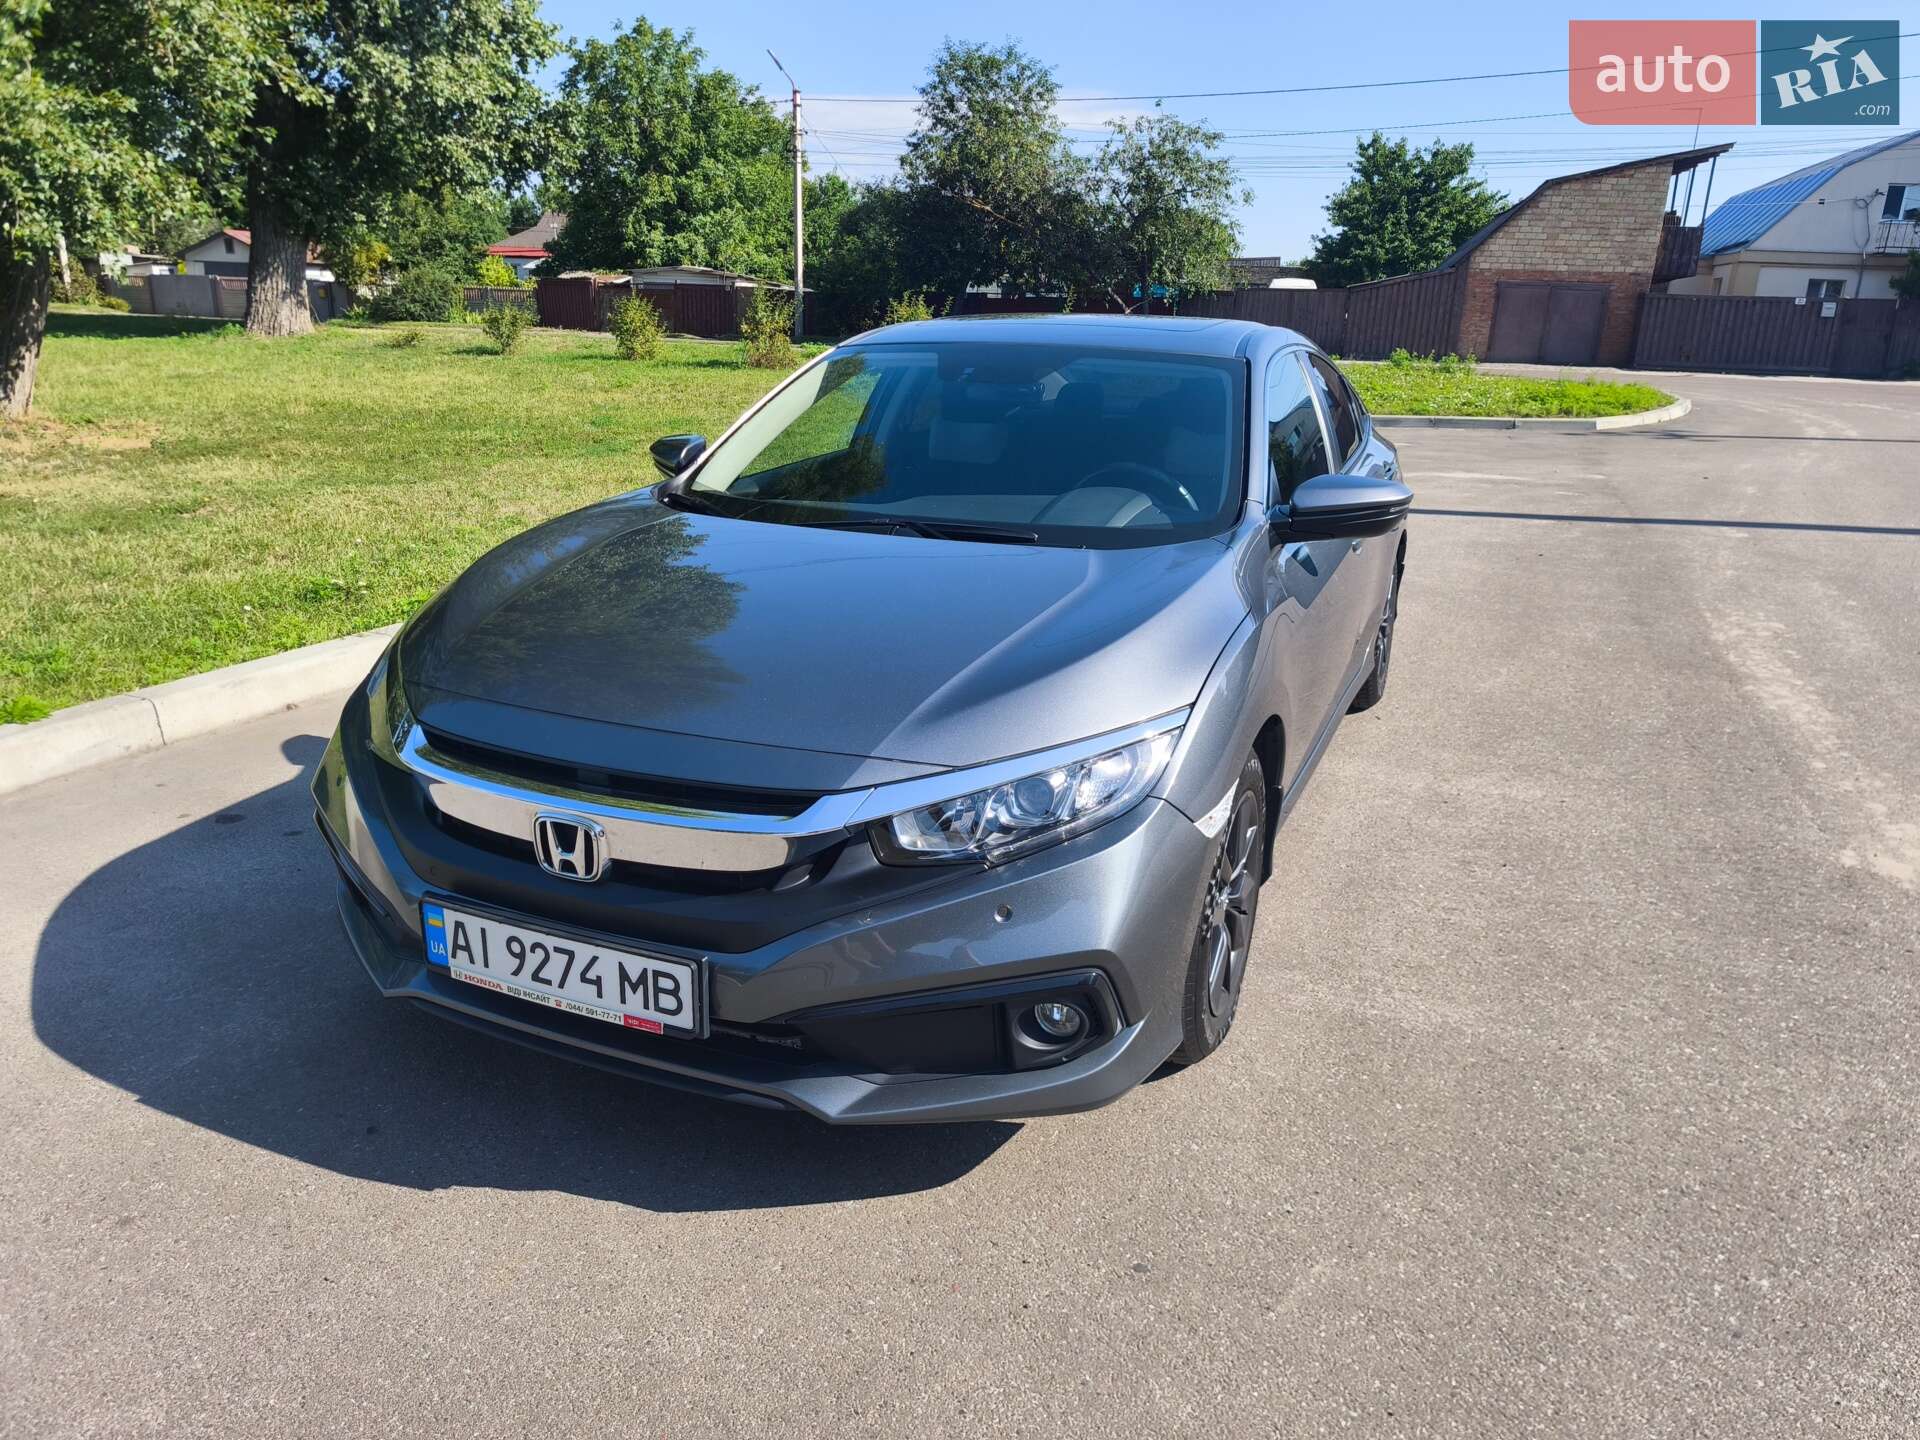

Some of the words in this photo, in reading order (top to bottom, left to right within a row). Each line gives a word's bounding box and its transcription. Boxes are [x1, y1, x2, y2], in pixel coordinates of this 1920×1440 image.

[430, 940, 447, 956] UA
[451, 920, 489, 968] AI
[505, 935, 603, 999] 9274
[618, 961, 684, 1017] MB
[464, 973, 504, 991] HONDA
